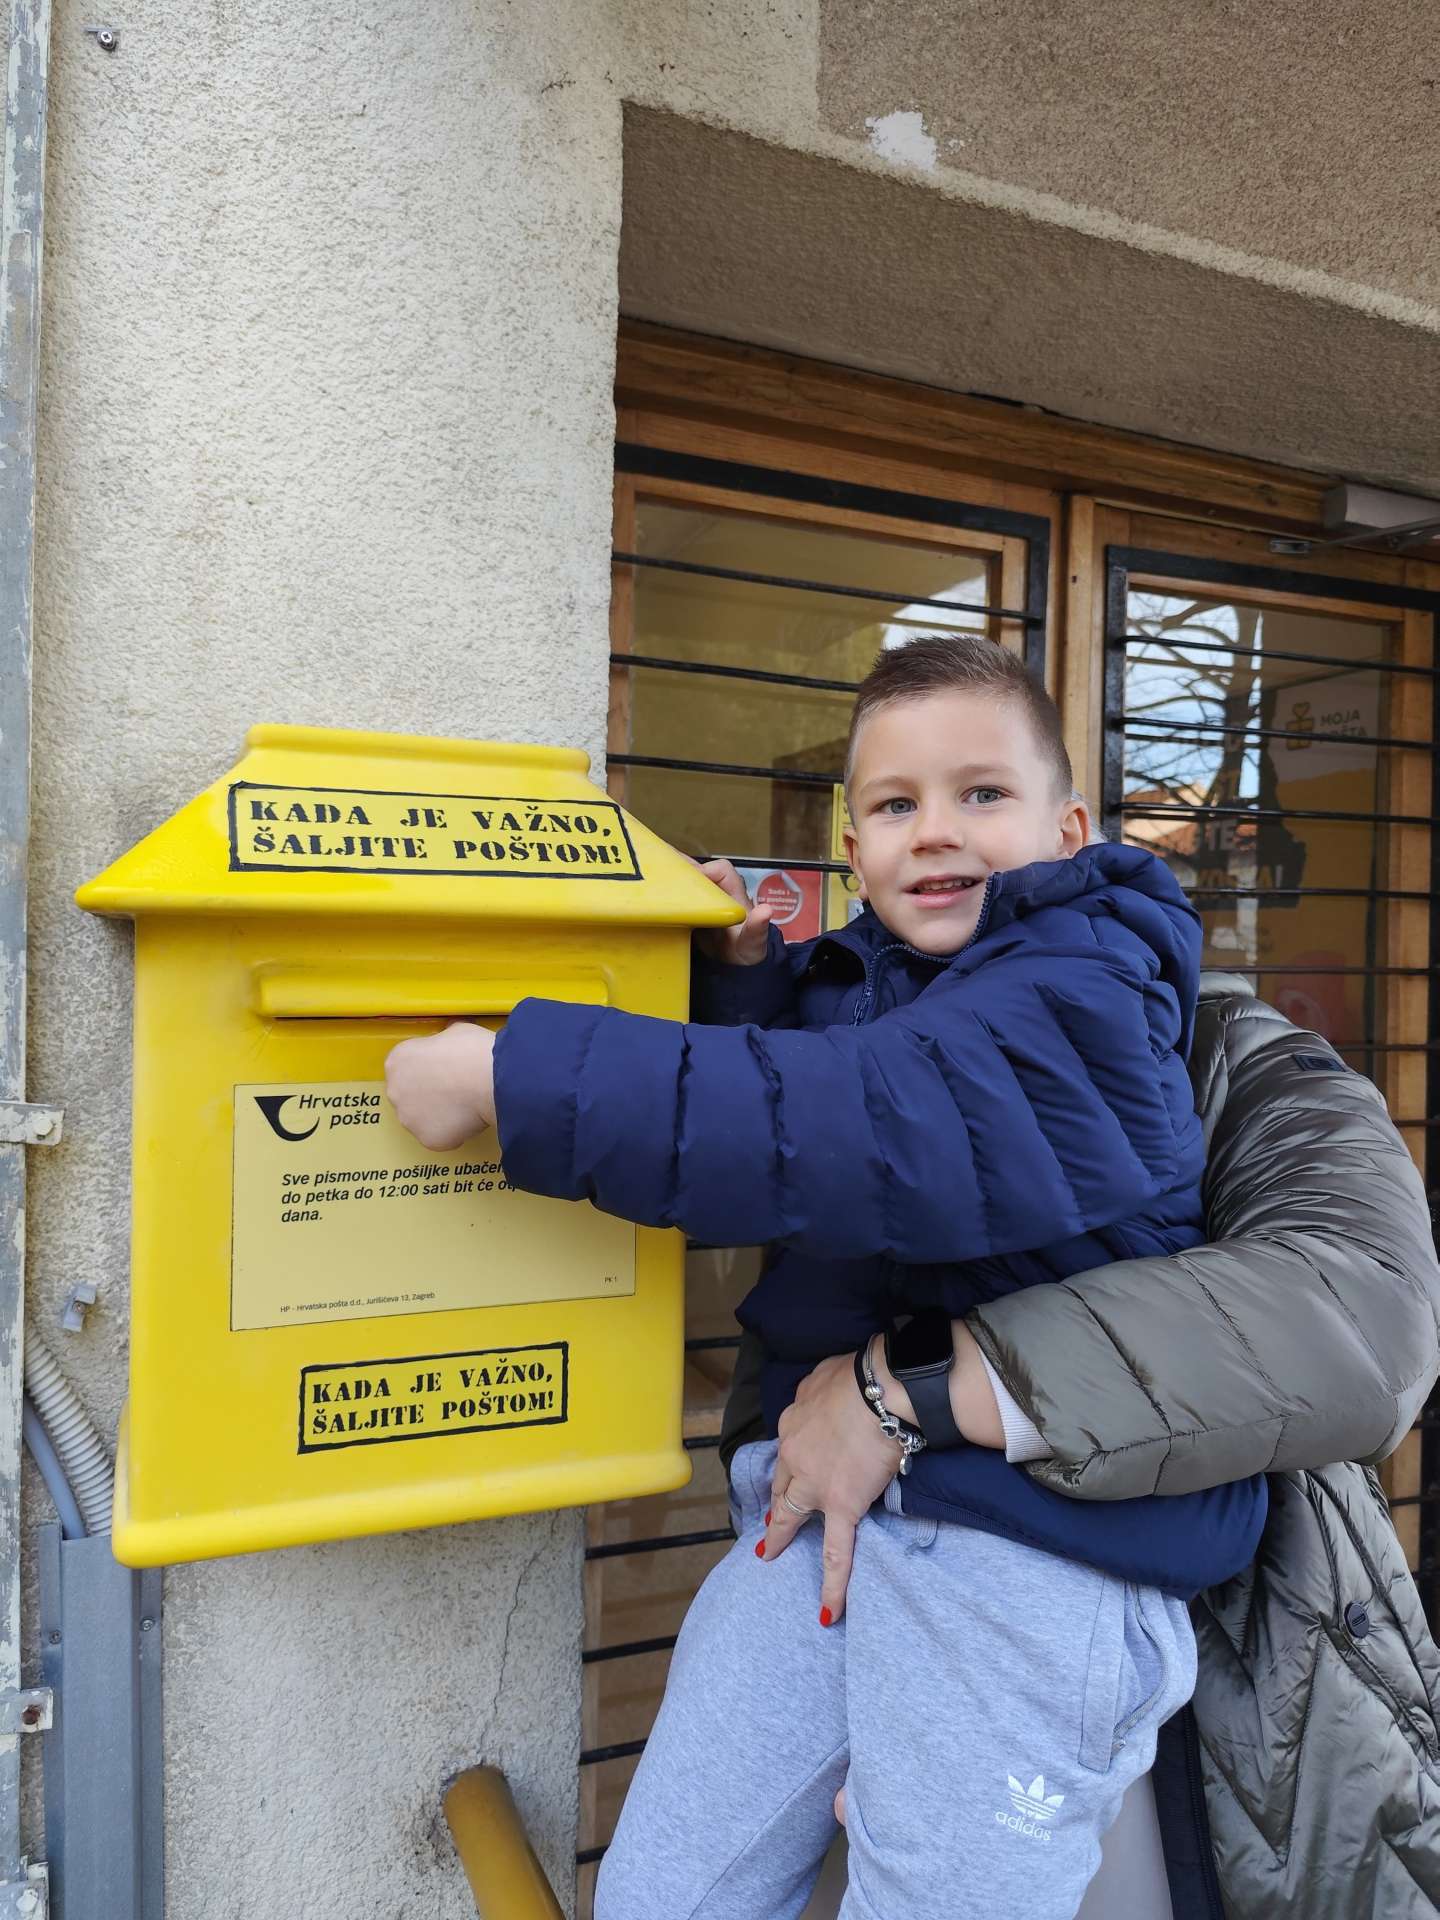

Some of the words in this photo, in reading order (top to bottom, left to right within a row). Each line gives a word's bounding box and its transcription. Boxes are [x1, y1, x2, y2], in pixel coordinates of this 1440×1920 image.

[1320, 709, 1360, 727] MOJA
[250, 800, 372, 826] KADA
[400, 808, 448, 829] JE
[472, 805, 612, 837] VAŽNO,
[253, 826, 428, 859] ŠALJITE
[453, 836, 622, 865] POŠTOM!
[299, 1092, 381, 1109] Hrvatska
[329, 1110, 381, 1130] pošta
[281, 1173, 310, 1186] Sve
[314, 1169, 388, 1187] pismovne
[392, 1164, 450, 1182] pošiljke
[281, 1191, 301, 1204] do
[305, 1188, 349, 1206] petka
[354, 1186, 373, 1199] do
[379, 1184, 419, 1198] 12:00
[422, 1181, 450, 1195] sati
[454, 1180, 473, 1193] bit
[477, 1178, 494, 1191] će
[281, 1209, 323, 1223] dana.
[296, 1302, 327, 1312] Hrvatska
[328, 1299, 348, 1310] pošta
[412, 1292, 435, 1302] Zagreb
[312, 1378, 391, 1404] KADA
[410, 1372, 442, 1394] JE
[459, 1358, 553, 1388] VAŽNO,
[312, 1404, 425, 1435] ŠALJITE
[441, 1390, 554, 1420] POŠTOM!
[995, 1811, 1052, 1841] adidas
